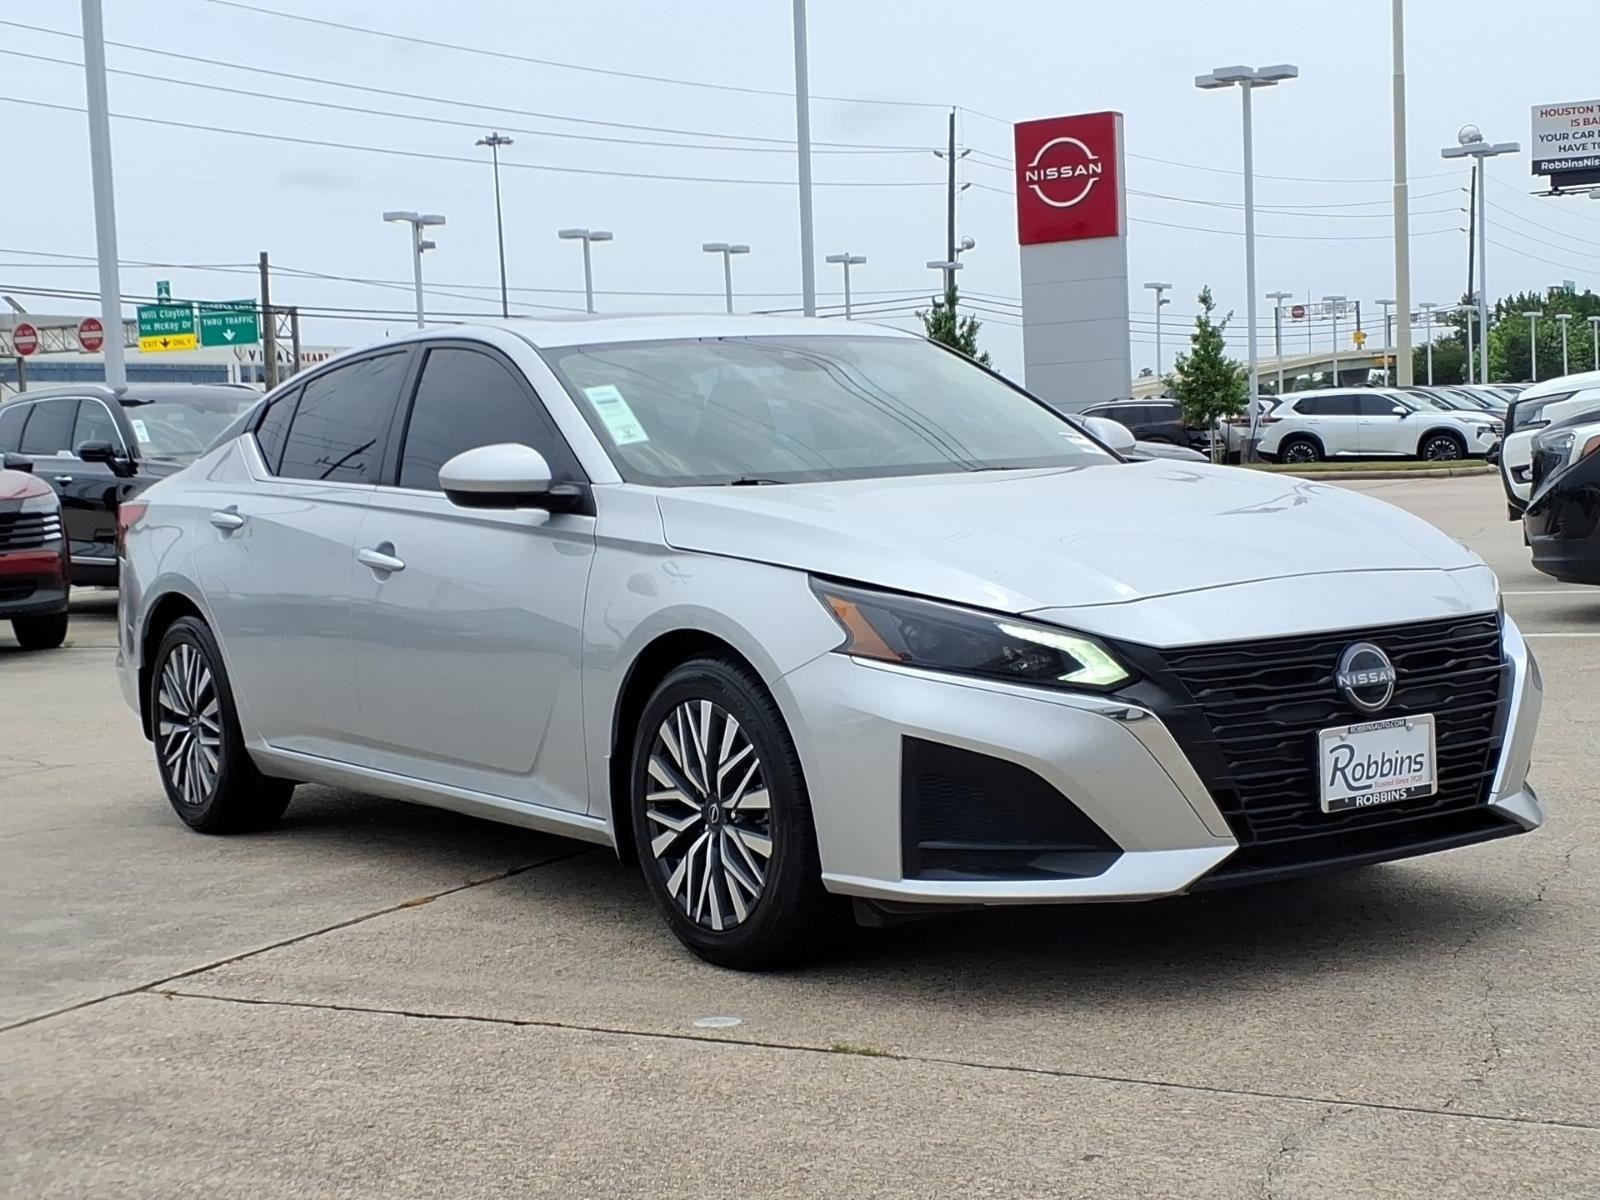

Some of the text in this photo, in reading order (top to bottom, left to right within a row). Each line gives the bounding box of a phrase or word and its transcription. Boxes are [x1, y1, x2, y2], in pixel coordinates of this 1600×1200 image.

[1540, 106, 1594, 117] HOUSTON
[1539, 133, 1569, 142] YOUR
[1572, 131, 1594, 139] CAR
[1559, 143, 1588, 152] HAVE
[1026, 162, 1101, 182] NISSAN
[141, 308, 191, 320] Will Clayton
[154, 322, 179, 332] McKay
[182, 320, 192, 329] Dr
[202, 316, 254, 327] THRU TRAFFIC
[143, 337, 191, 348] EXIT ONLY
[248, 350, 292, 363] VIAL
[1338, 671, 1396, 685] NISSAN
[1329, 743, 1424, 792] Robbins
[1356, 788, 1407, 807] ROBBINS
